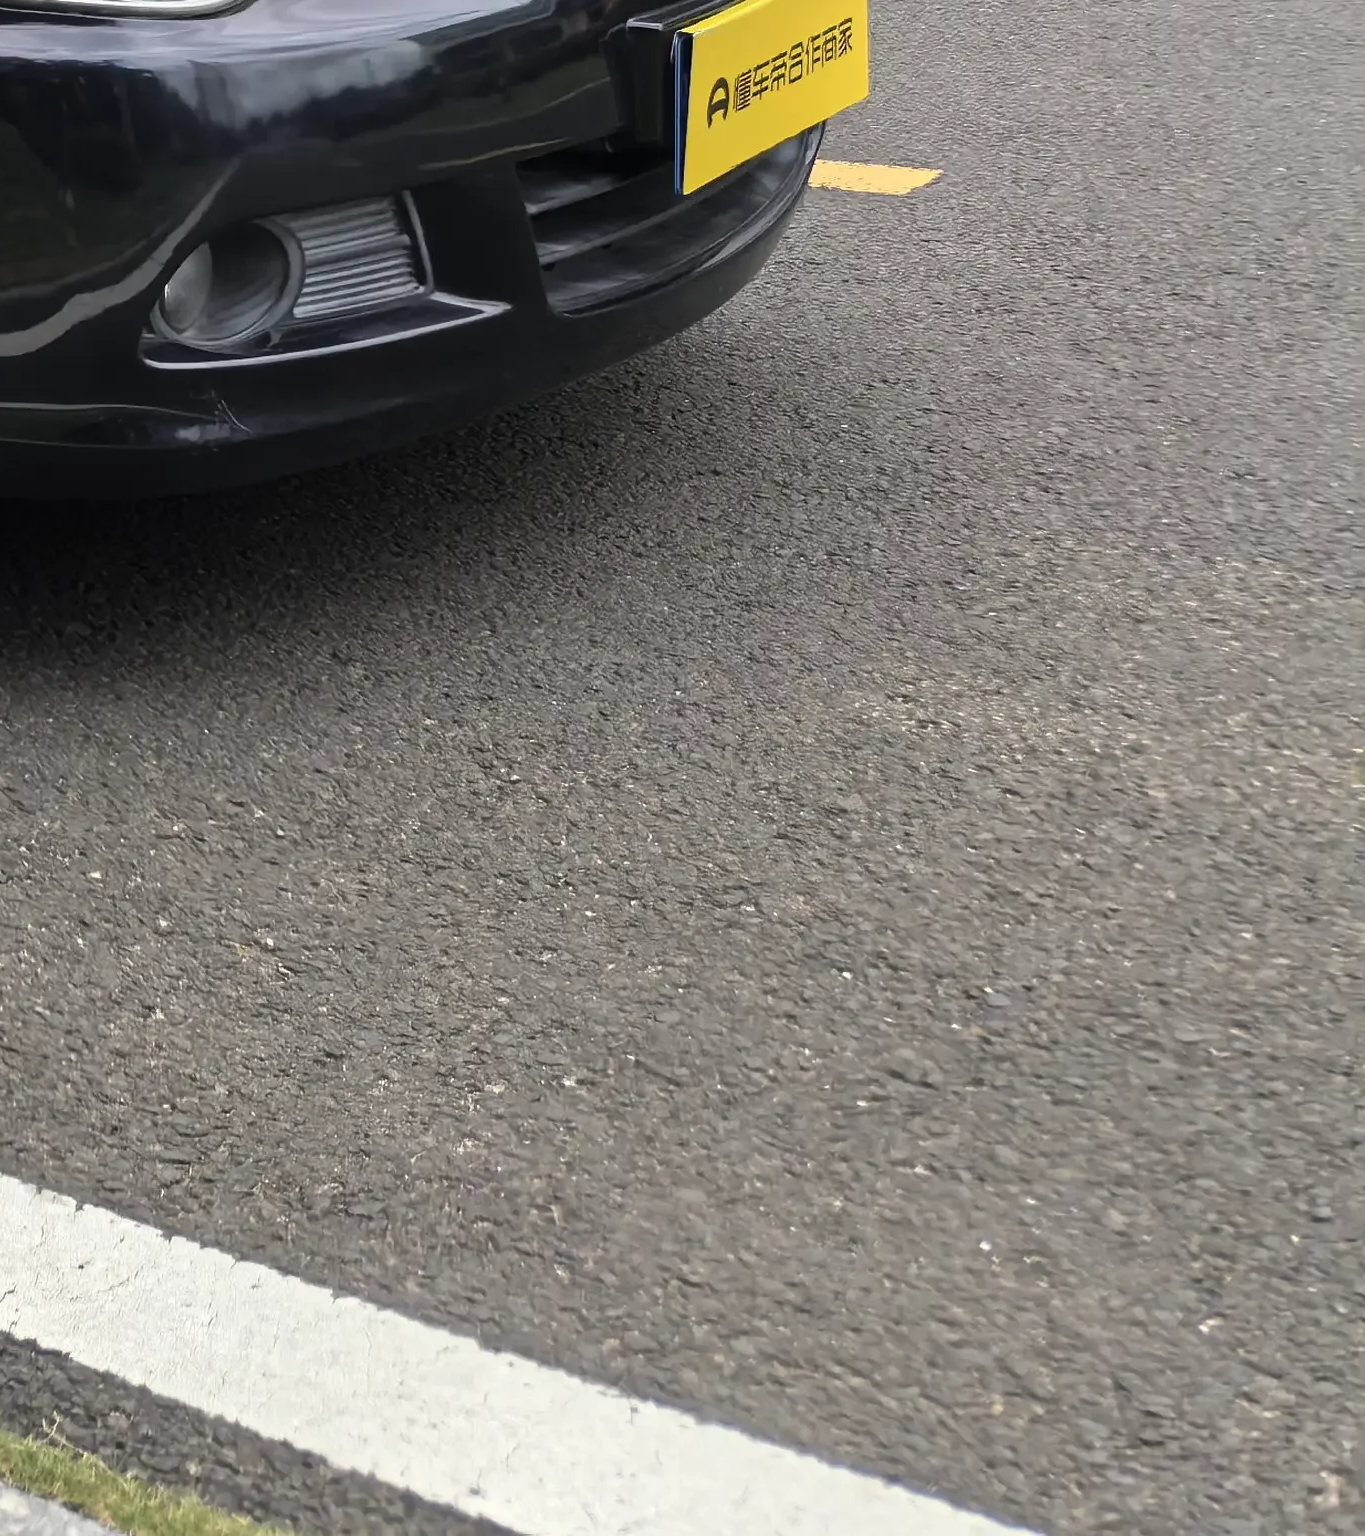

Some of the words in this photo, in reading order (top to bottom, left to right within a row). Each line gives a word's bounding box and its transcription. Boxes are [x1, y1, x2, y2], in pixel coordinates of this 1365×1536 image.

[732, 17, 853, 113] 懂车帝合作商家
